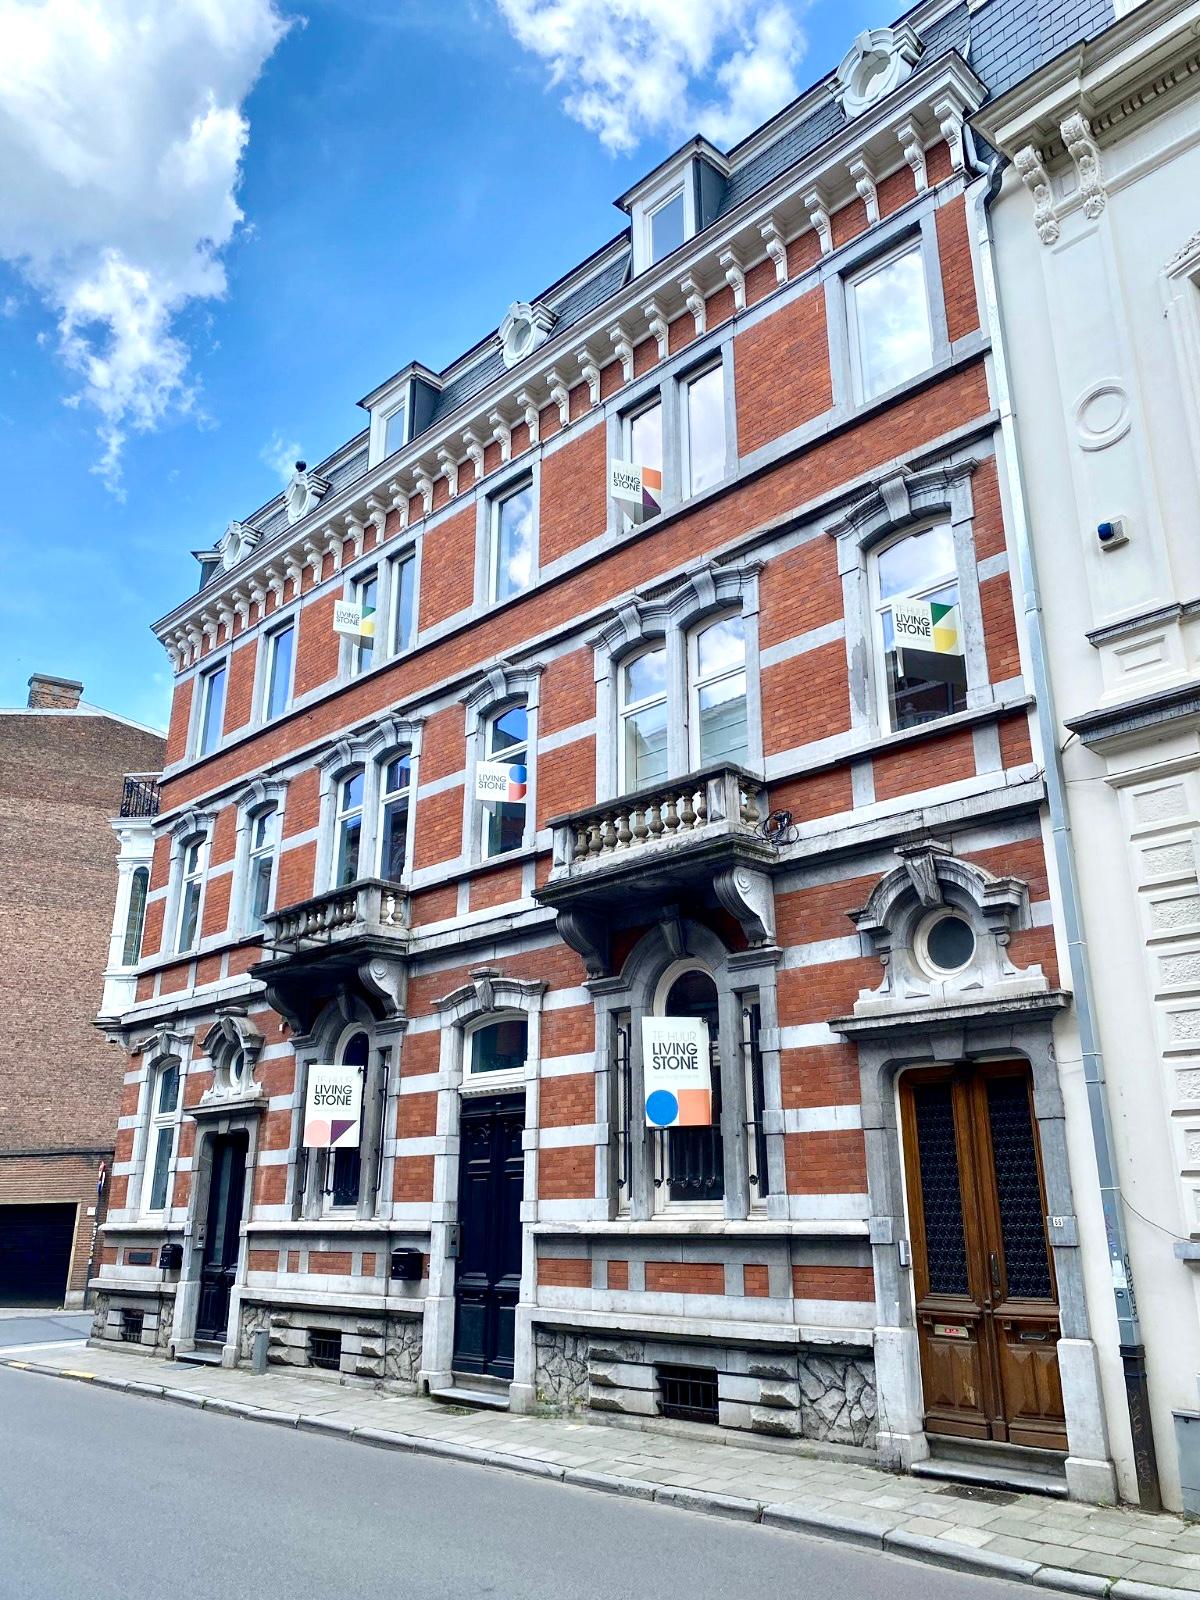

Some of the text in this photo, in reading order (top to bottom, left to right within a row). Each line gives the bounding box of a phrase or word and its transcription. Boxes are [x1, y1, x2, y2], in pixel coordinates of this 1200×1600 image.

[613, 472, 640, 484] LIVING
[613, 479, 640, 492] STONE
[336, 610, 360, 619] LIVING
[896, 613, 930, 626] LIVING
[336, 616, 360, 626] STONE
[896, 622, 931, 637] STONE
[479, 774, 507, 782] LIVING
[478, 780, 507, 790] STONE
[668, 1031, 696, 1041] HUUR
[652, 1042, 698, 1055] LIVING
[652, 1056, 698, 1070] STONE
[315, 1084, 352, 1094] LIVING
[313, 1094, 352, 1105] STONE
